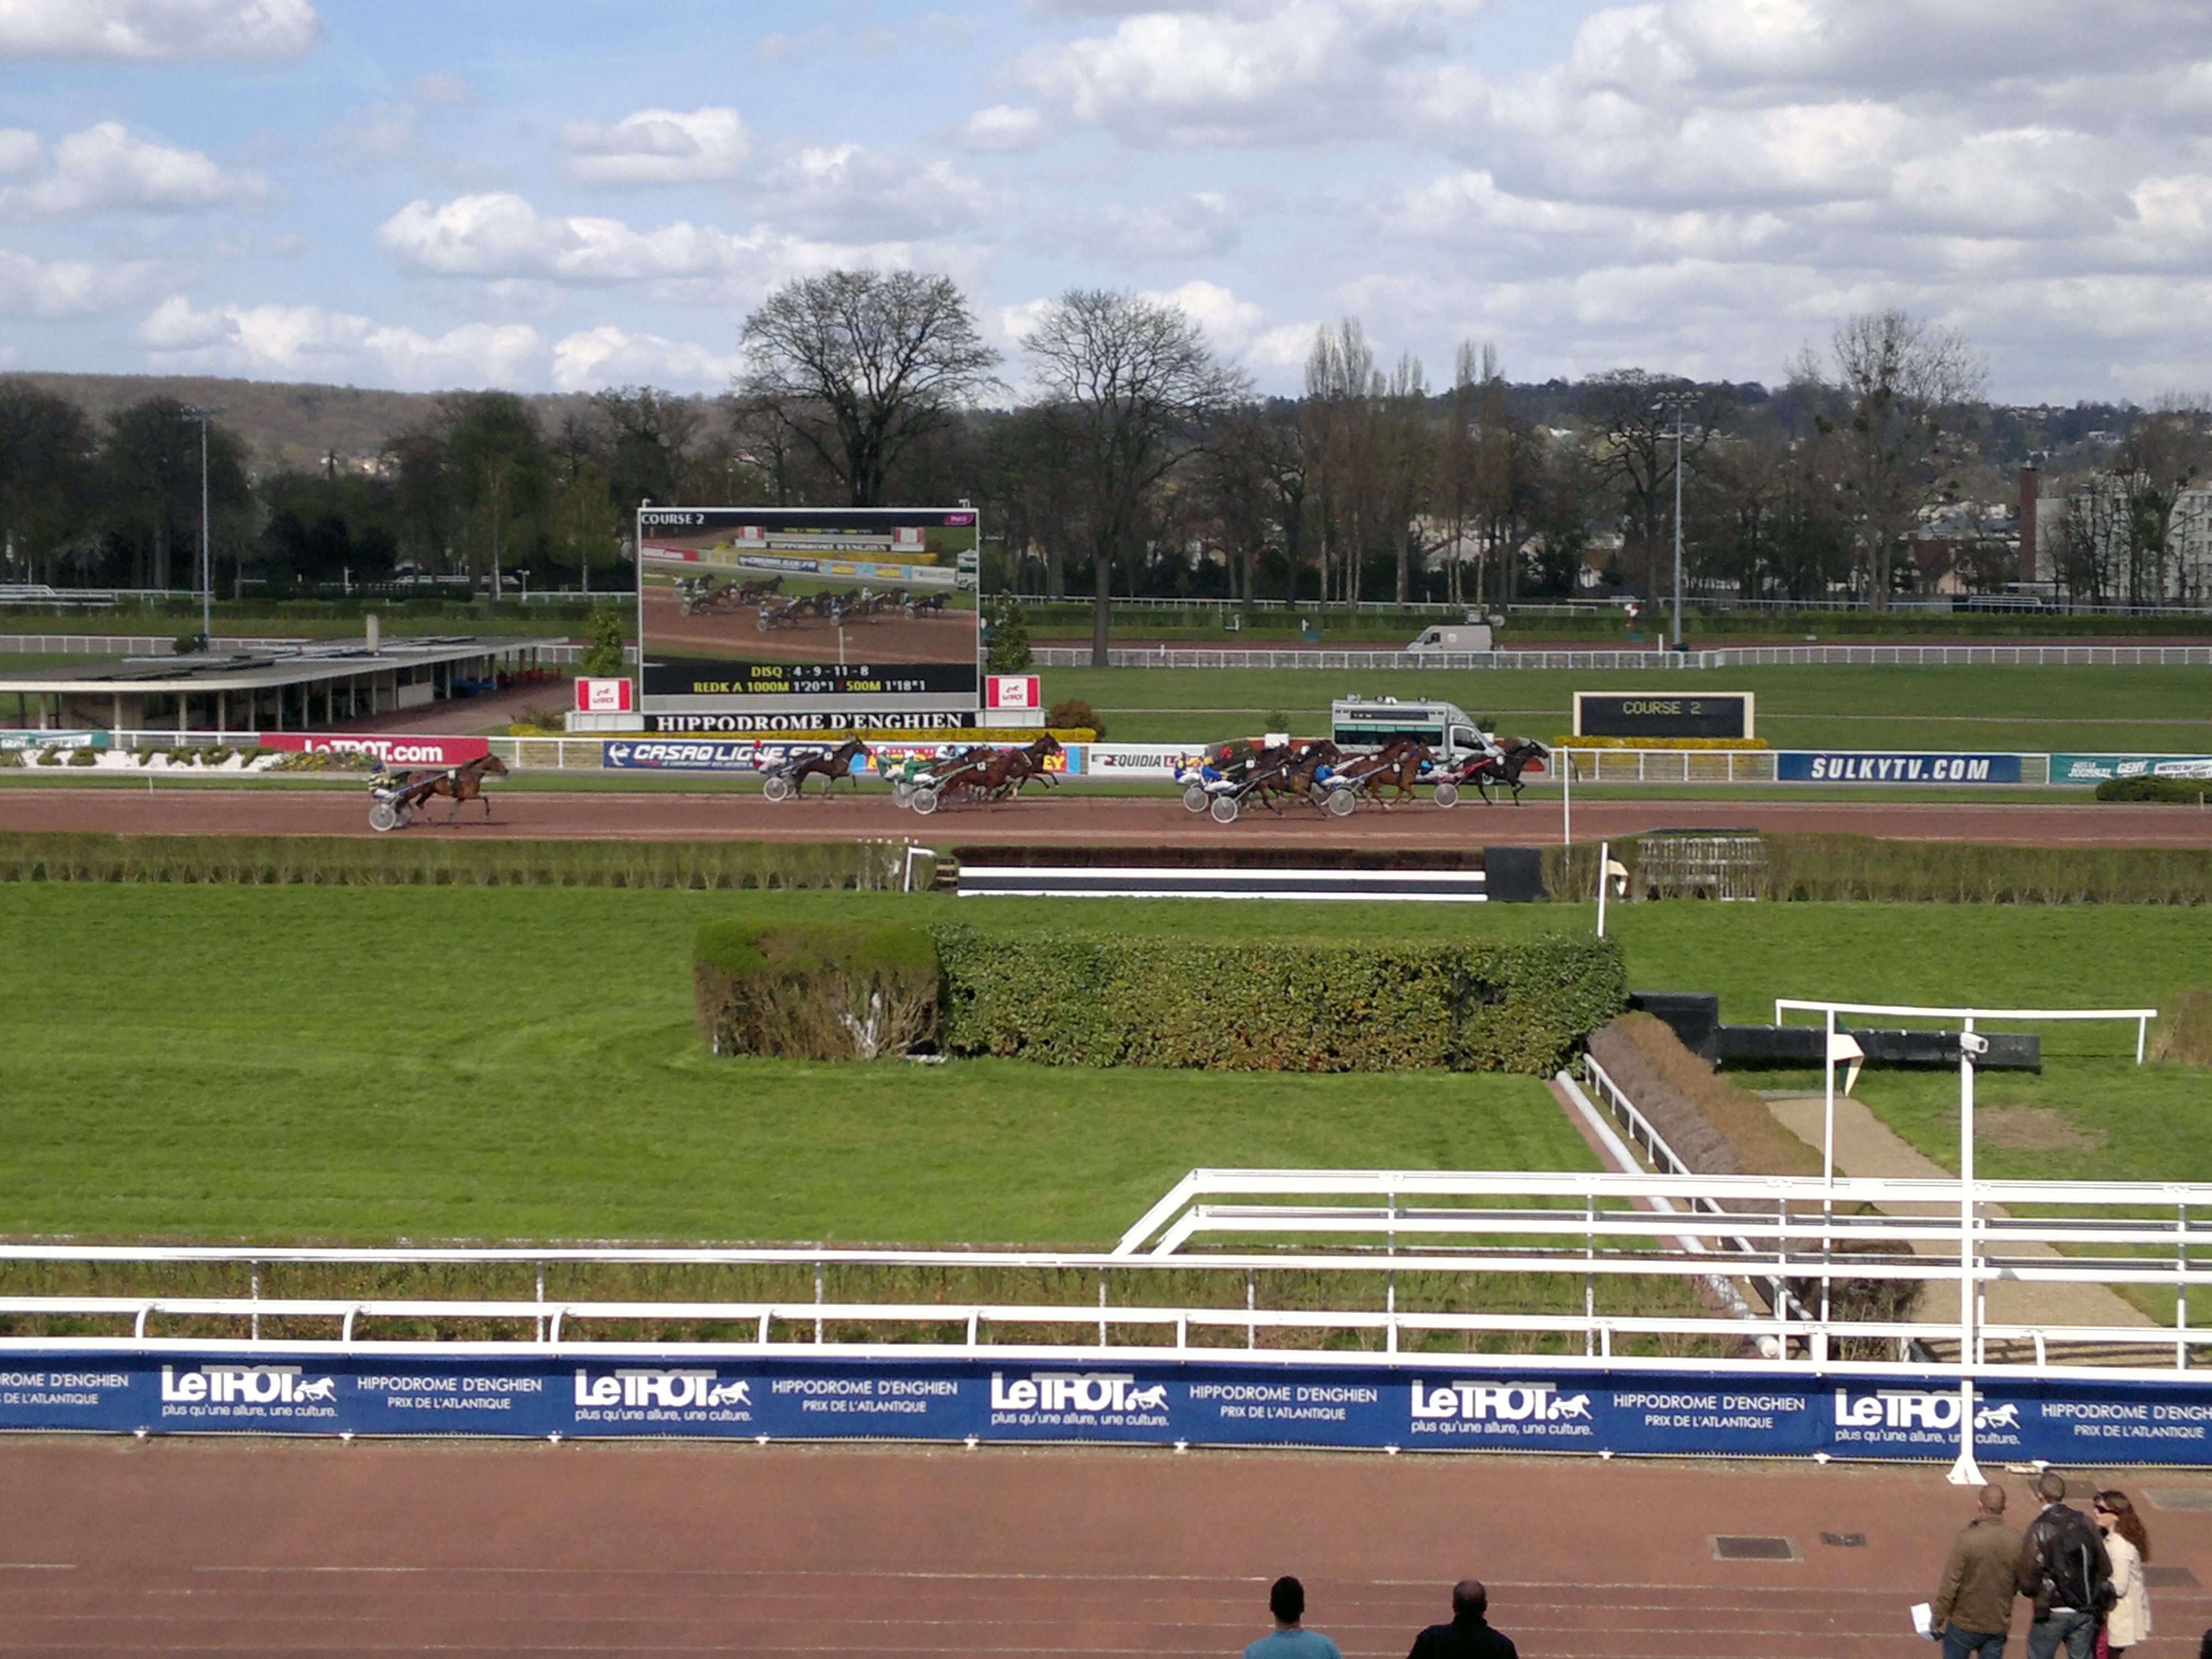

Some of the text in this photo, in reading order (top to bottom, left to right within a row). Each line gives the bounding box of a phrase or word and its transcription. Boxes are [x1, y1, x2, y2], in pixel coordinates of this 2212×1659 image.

[641, 514, 705, 524] COURSE 2
[751, 666, 783, 678] DISQ
[793, 666, 802, 676] 4
[813, 666, 822, 676] 9
[834, 666, 848, 676] 11
[860, 666, 869, 676] 8
[693, 682, 729, 692] REDK
[732, 682, 743, 692] A
[748, 681, 789, 691] 1000M
[846, 681, 881, 691] 500M
[1623, 701, 1701, 714] COURSE 2
[657, 713, 962, 731] HIPPODROME D'ENGHIEN
[633, 745, 713, 760] CASAQ
[1110, 754, 1161, 768] EQUIDIA
[1811, 757, 1990, 780] SULKYTV.COM
[0, 1373, 129, 1387] ROME D'ENGHIEN
[357, 1376, 542, 1392] HIPPODROME D'ENGHIEN
[772, 1380, 958, 1396] HIPPODROME D'ENGHIEN
[1190, 1385, 1378, 1403] HIPPODROME D'ENGHIEN
[3, 1392, 98, 1405] DE L'ATLANTIQUE
[388, 1397, 511, 1410] PRIX DE L'ATLANTIQUE
[1613, 1394, 1806, 1411] HIPPODROME D'ENGHIEN
[163, 1404, 338, 1417] plus qu'une allure, une culture.
[802, 1400, 926, 1412] PRIX DE L'ATLANTIQUE
[1220, 1406, 1345, 1420] PRIX DE L'ATLANTIQUE
[2041, 1404, 2148, 1419] HIPPODROME
[575, 1408, 753, 1422] plus qu'une allure, une culture.
[992, 1412, 1170, 1426] plus qu'une allure, une culture.
[1645, 1415, 1773, 1428] PRIX DE L'ATLANTIQUE
[1411, 1421, 1593, 1435] plus qu'une allure, une culture.
[2075, 1425, 2204, 1438] PRIX DE L'ATLANTIQUE
[1835, 1430, 2021, 1444] plus qu'une allure, un culture.
